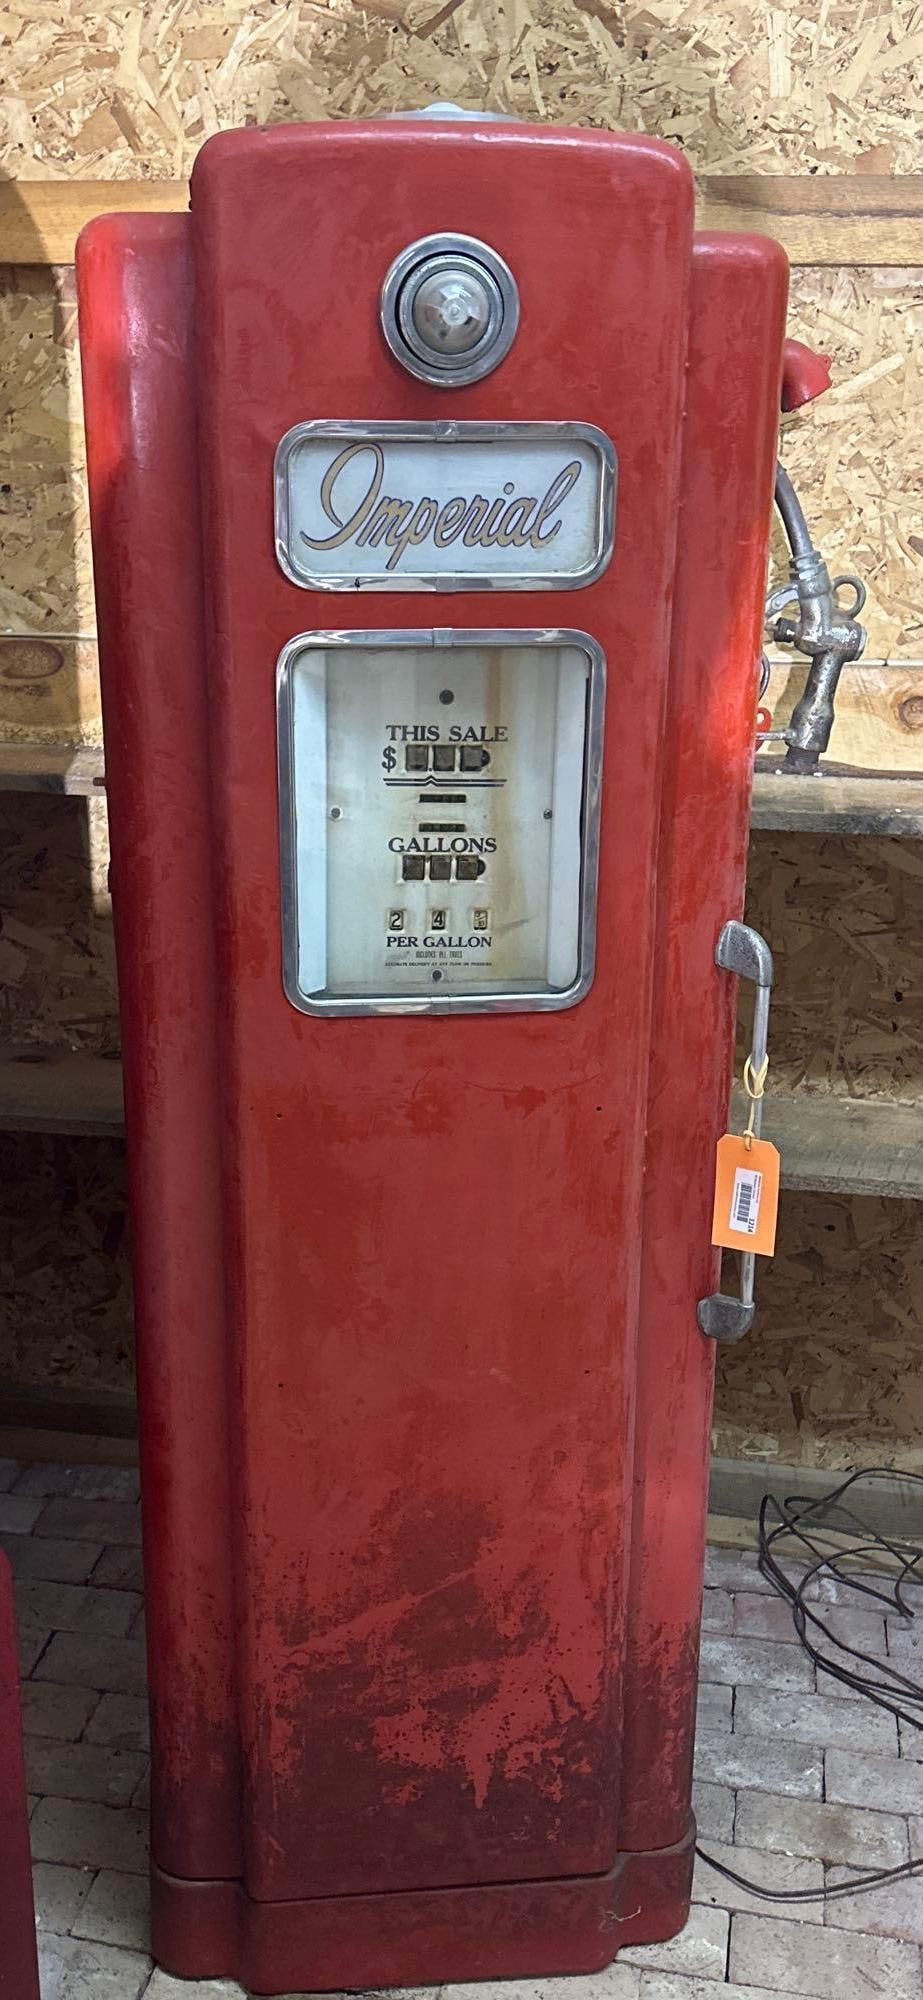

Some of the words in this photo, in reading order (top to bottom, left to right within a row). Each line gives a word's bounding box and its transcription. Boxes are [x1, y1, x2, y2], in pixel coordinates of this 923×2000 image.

[299, 441, 582, 571] Imperial
[385, 725, 440, 742] THIS
[448, 726, 509, 742] SALE
[381, 745, 397, 774] $
[388, 837, 498, 853] GALLONS
[391, 912, 401, 928] 2
[433, 911, 443, 926] 4
[386, 936, 419, 948] PER
[422, 936, 492, 948] GALLON
